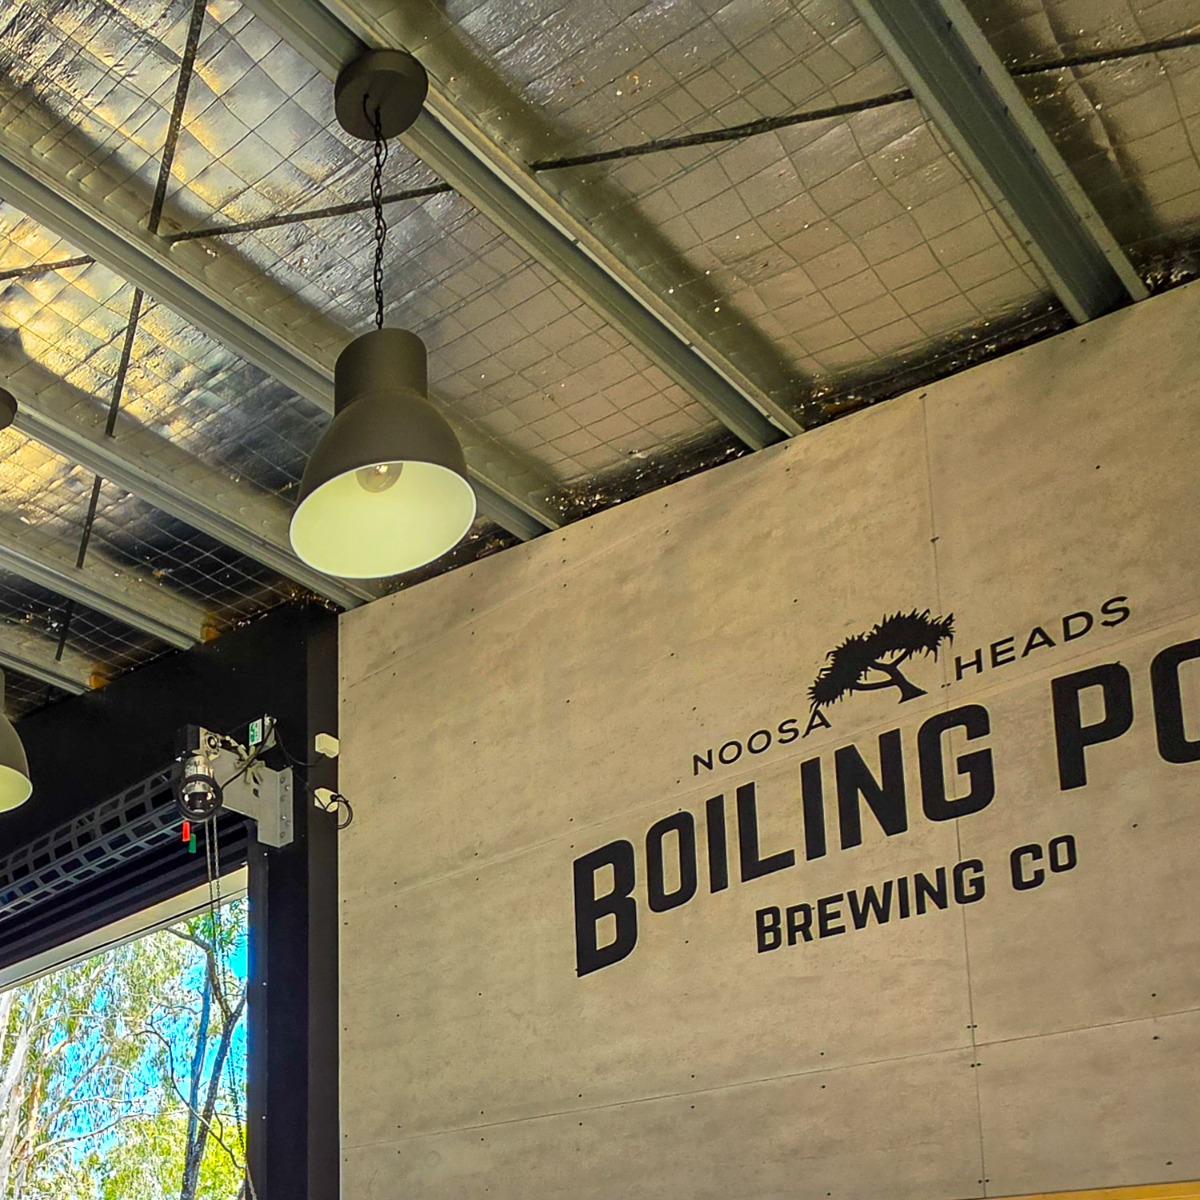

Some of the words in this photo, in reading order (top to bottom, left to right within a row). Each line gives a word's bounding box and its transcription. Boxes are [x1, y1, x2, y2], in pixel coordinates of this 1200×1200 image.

[693, 708, 832, 776] NOOSA
[954, 596, 1131, 681] HEADS
[573, 704, 996, 978] BOILING
[1050, 638, 1200, 791] PO
[756, 859, 986, 954] BREWING
[1010, 834, 1078, 891] CO
